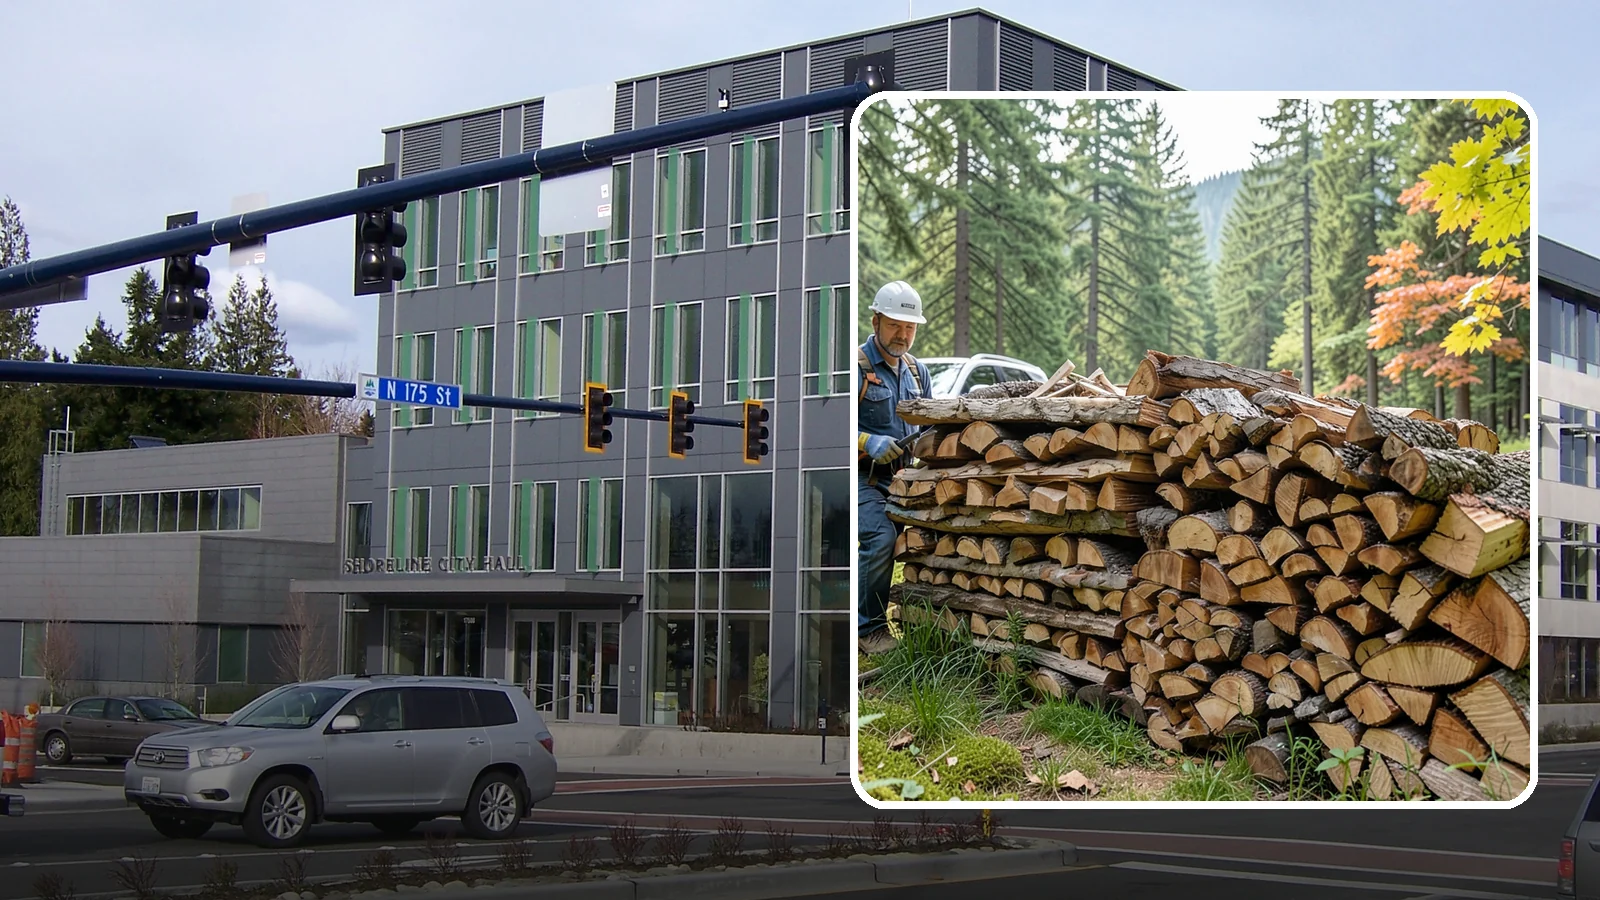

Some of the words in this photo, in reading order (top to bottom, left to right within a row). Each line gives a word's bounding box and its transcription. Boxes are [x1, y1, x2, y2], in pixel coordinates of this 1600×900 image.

[387, 380, 396, 399] N
[405, 382, 427, 403] 175
[436, 386, 451, 406] St
[344, 557, 432, 574] SHORELINE
[438, 556, 475, 572] CITY
[483, 555, 526, 571] HALL
